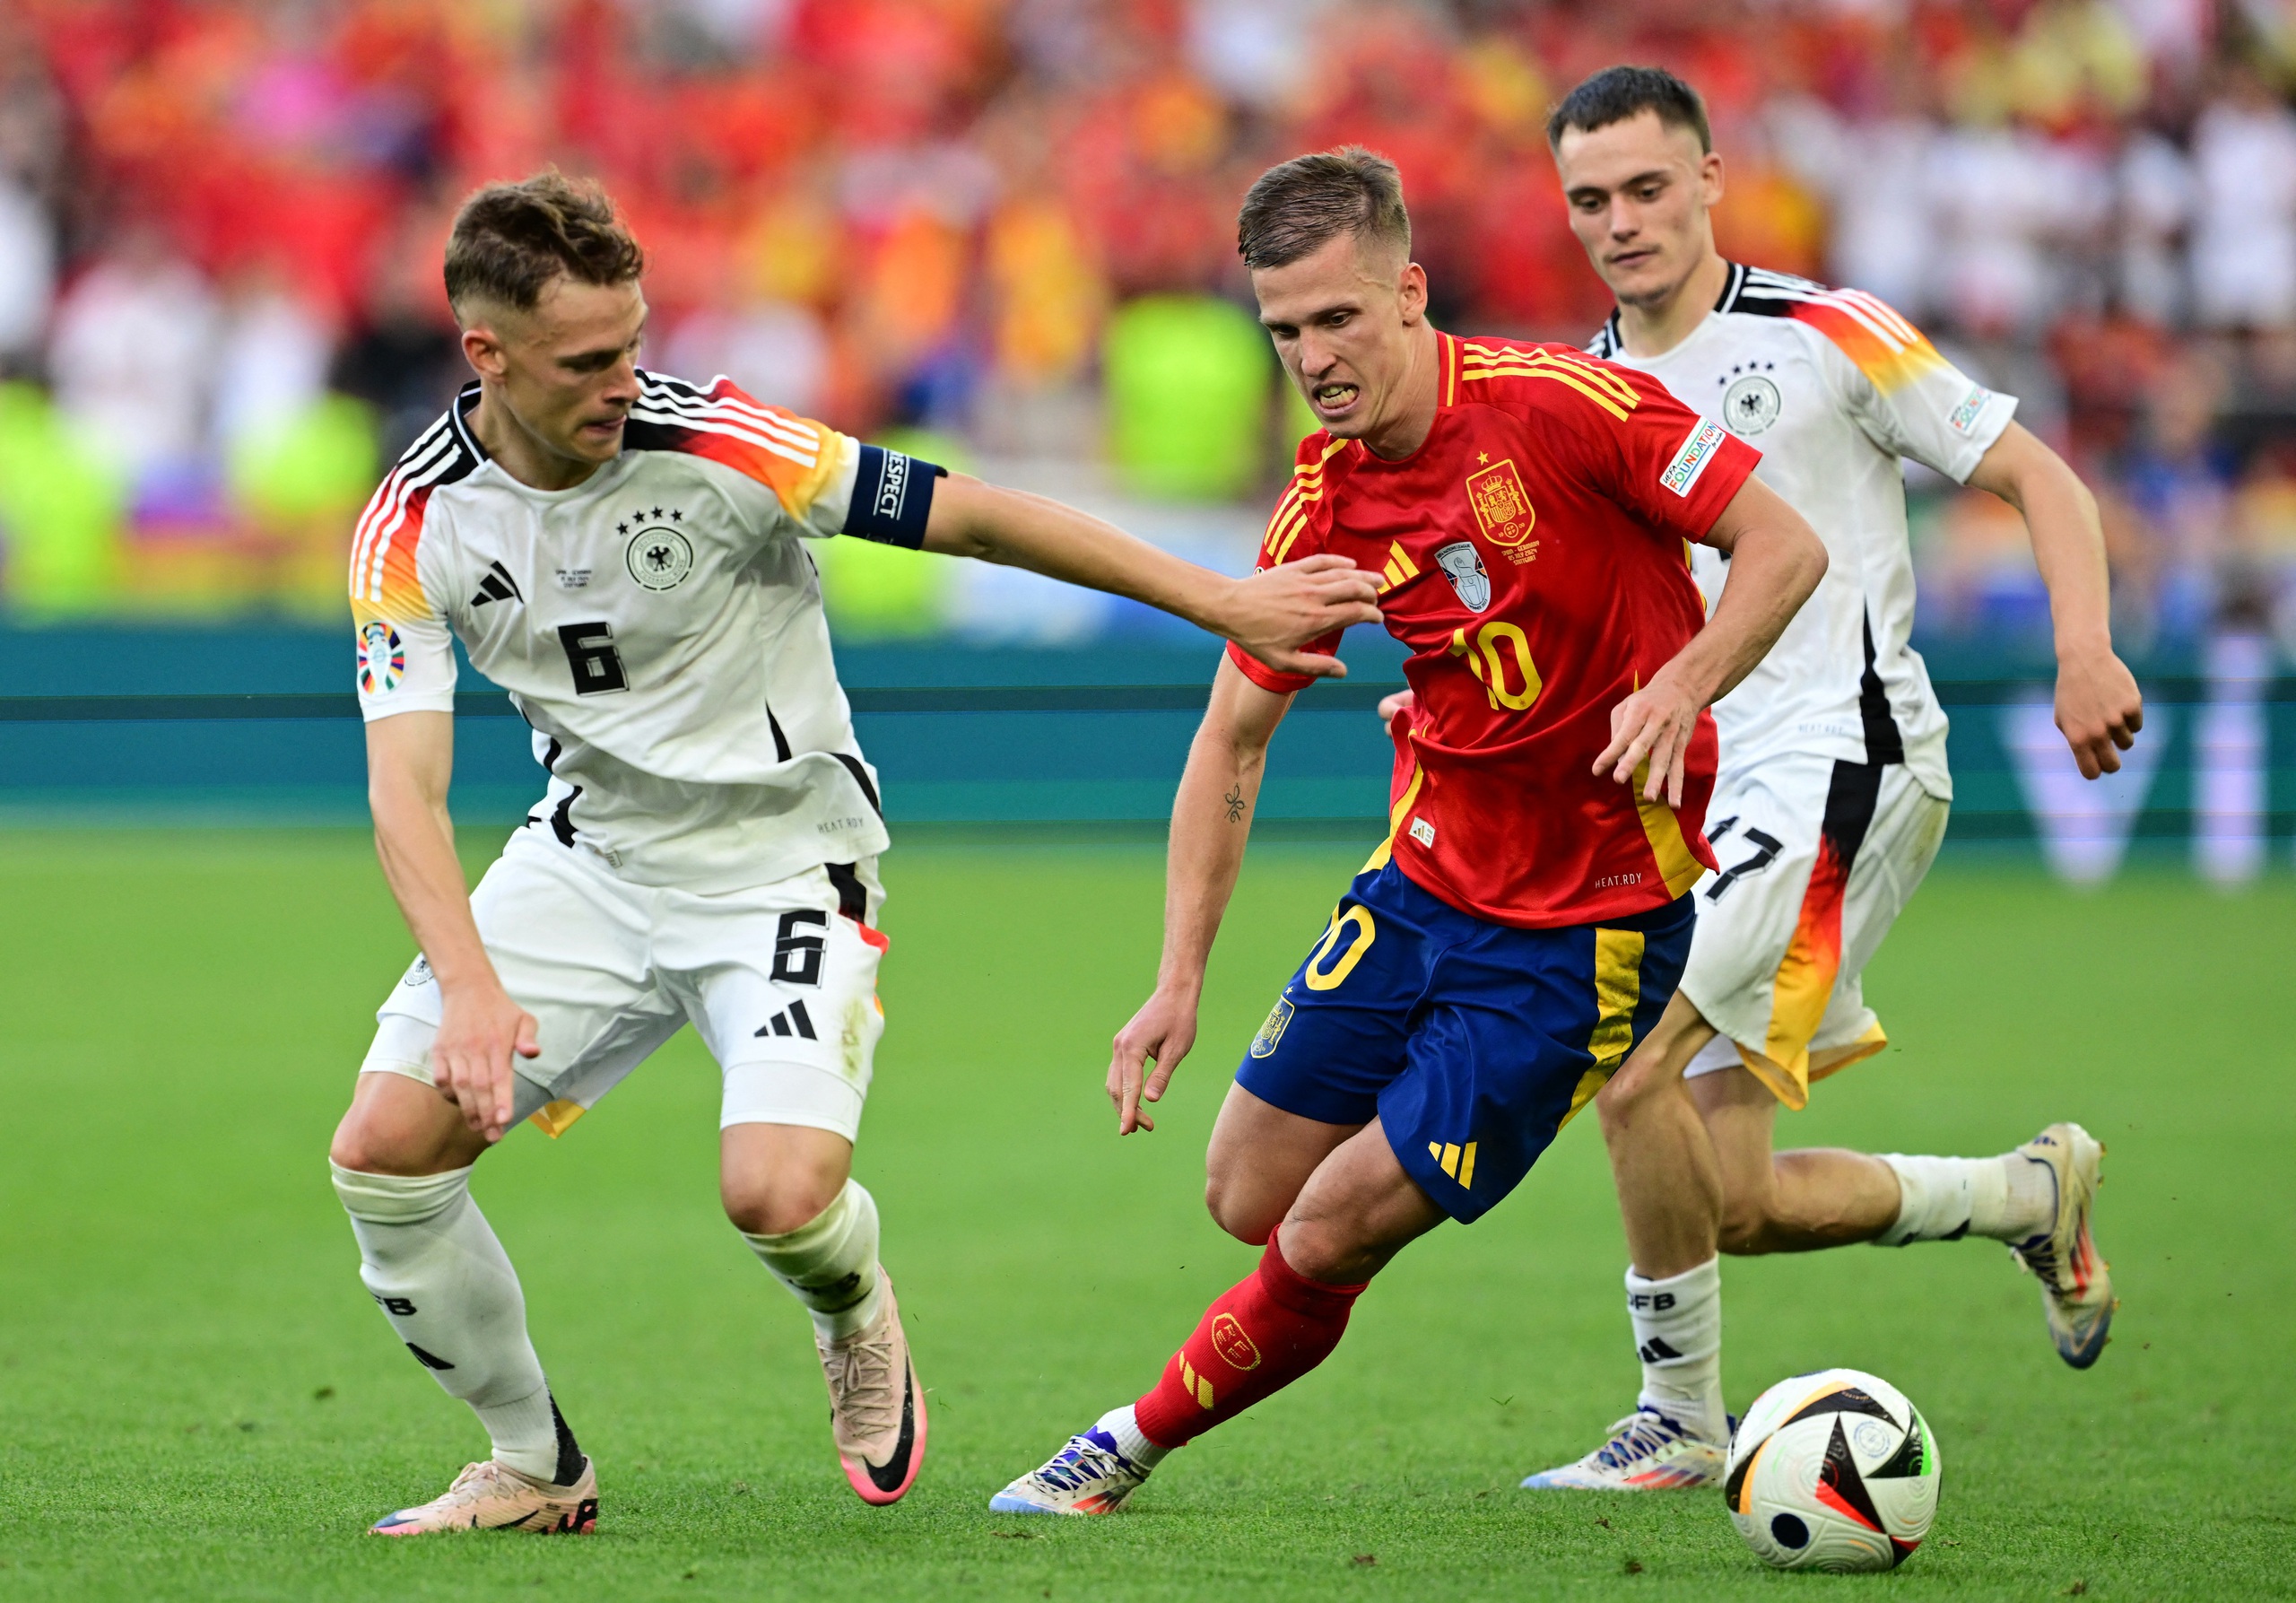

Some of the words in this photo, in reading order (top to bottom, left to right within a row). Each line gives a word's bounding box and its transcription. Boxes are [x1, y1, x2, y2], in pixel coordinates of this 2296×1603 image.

[1663, 465, 1677, 484] UEFA
[558, 622, 630, 697] 6
[1448, 622, 1543, 710] 10
[817, 817, 863, 834] HEATRDY
[1595, 872, 1641, 889] HEAT.RDY
[770, 910, 831, 989] 6
